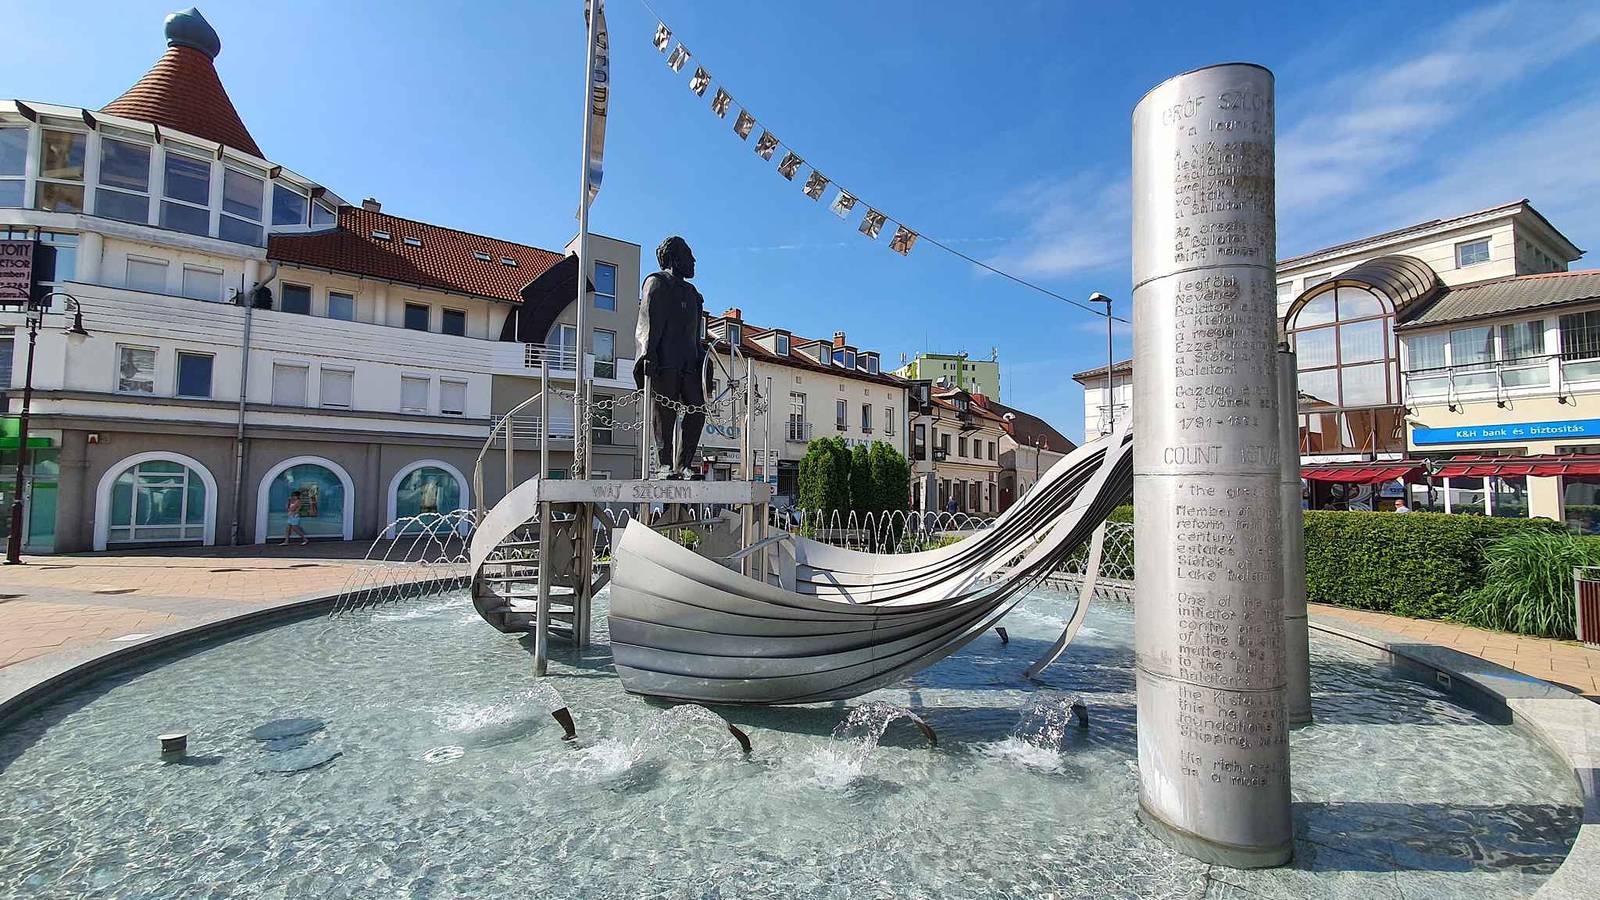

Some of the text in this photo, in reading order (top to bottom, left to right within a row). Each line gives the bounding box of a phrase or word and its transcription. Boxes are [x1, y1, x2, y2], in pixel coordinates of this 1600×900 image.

[1176, 303, 1231, 317] Balaton
[1176, 319, 1186, 329] a
[1176, 332, 1185, 341] a
[1176, 340, 1219, 354] Ezzel
[1176, 357, 1185, 365] a
[1456, 425, 1585, 438] K&H bank és biztosítás
[1165, 446, 1222, 465] COUNT
[1177, 567, 1216, 581] Lake
[1178, 593, 1206, 607] One
[1179, 631, 1194, 643] of
[1202, 632, 1229, 647] the
[1201, 658, 1223, 672] the
[1178, 686, 1202, 701] the
[1179, 698, 1205, 713] this
